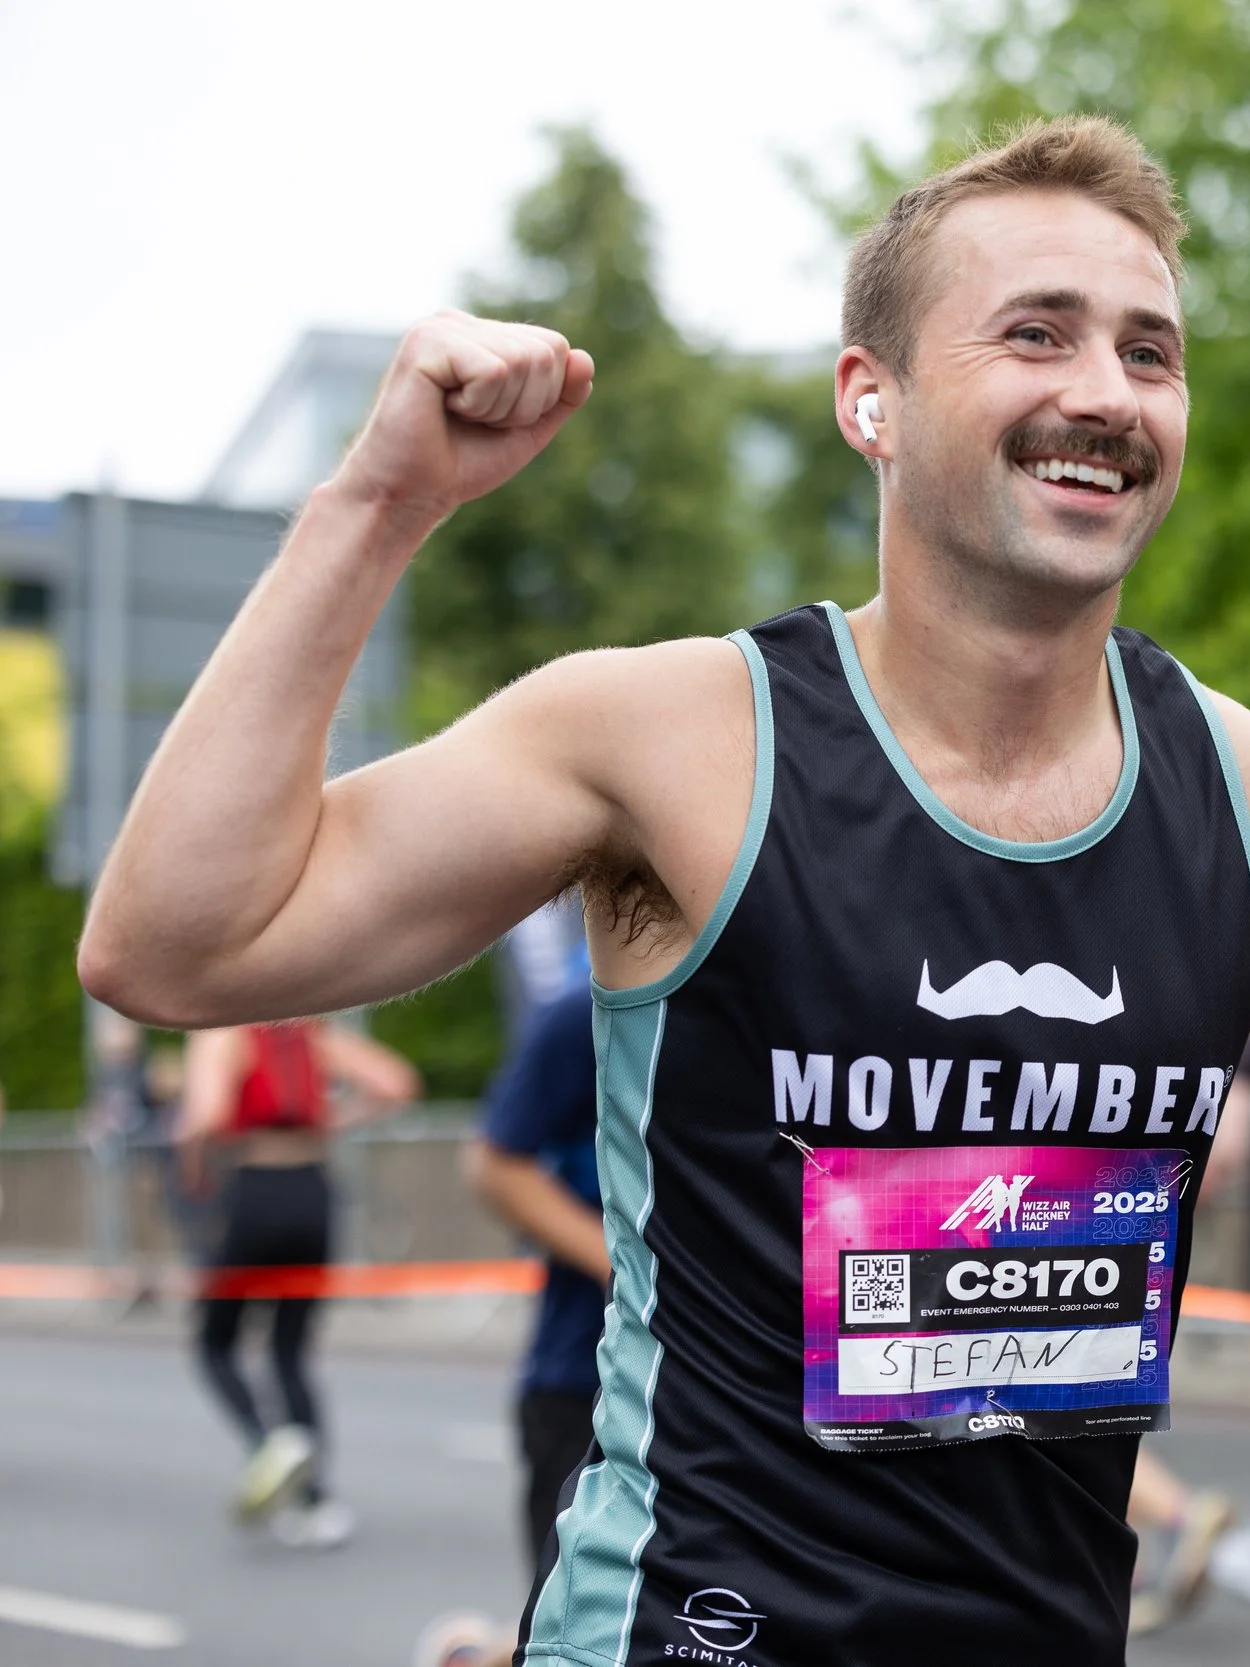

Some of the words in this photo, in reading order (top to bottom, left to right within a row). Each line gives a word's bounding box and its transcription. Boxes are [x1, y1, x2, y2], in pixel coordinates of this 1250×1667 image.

[771, 1048, 1225, 1136] MOVEMBER
[1095, 1166, 1171, 1188] 2025
[1022, 1201, 1049, 1211] WIZZ
[1052, 1201, 1070, 1210] AIR
[1093, 1190, 1169, 1214] 2025
[1022, 1211, 1070, 1221] HACKNEY
[1022, 1222, 1049, 1231] HALF
[1093, 1215, 1169, 1240] 2025
[945, 1257, 1120, 1301] C8170
[920, 1308, 953, 1317] EVENT
[953, 1305, 1009, 1315] EMERGENCY
[1009, 1304, 1049, 1313] NUMBER
[1060, 1303, 1081, 1312] 0303
[1082, 1303, 1102, 1311] 0401
[1103, 1302, 1119, 1310] 403
[880, 1329, 1083, 1393] STEFAN
[968, 1414, 1025, 1432] C8170
[664, 1643, 758, 1667] SCIMITA
